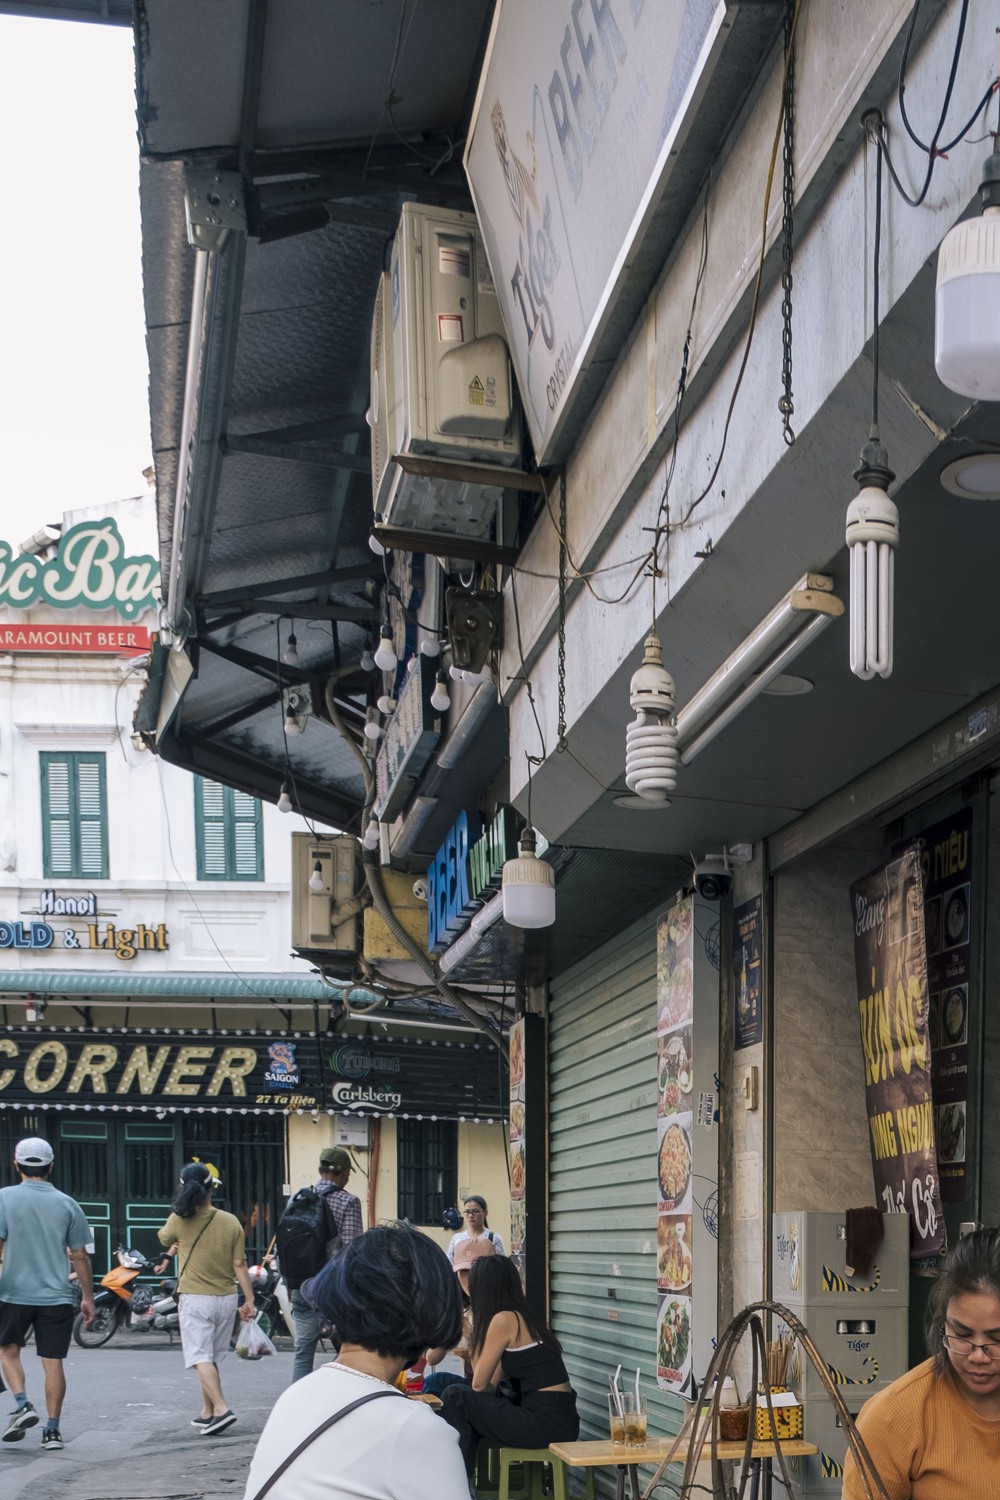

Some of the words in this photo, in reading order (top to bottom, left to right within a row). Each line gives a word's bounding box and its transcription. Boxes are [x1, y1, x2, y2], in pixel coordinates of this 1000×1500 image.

[511, 194, 561, 352] Tiger
[98, 632, 136, 646] BEER
[428, 809, 468, 952] BEER
[40, 889, 97, 915] Hanoi
[63, 929, 80, 948] &
[87, 923, 169, 960] Light
[0, 1039, 257, 1097] CORNER
[342, 1054, 400, 1072] TUBORG
[265, 1073, 298, 1083] SAIGON
[269, 1081, 294, 1089] CHILL
[256, 1095, 271, 1104] 27
[332, 1082, 402, 1108] Carlsberg
[847, 1339, 871, 1353] Tiger
